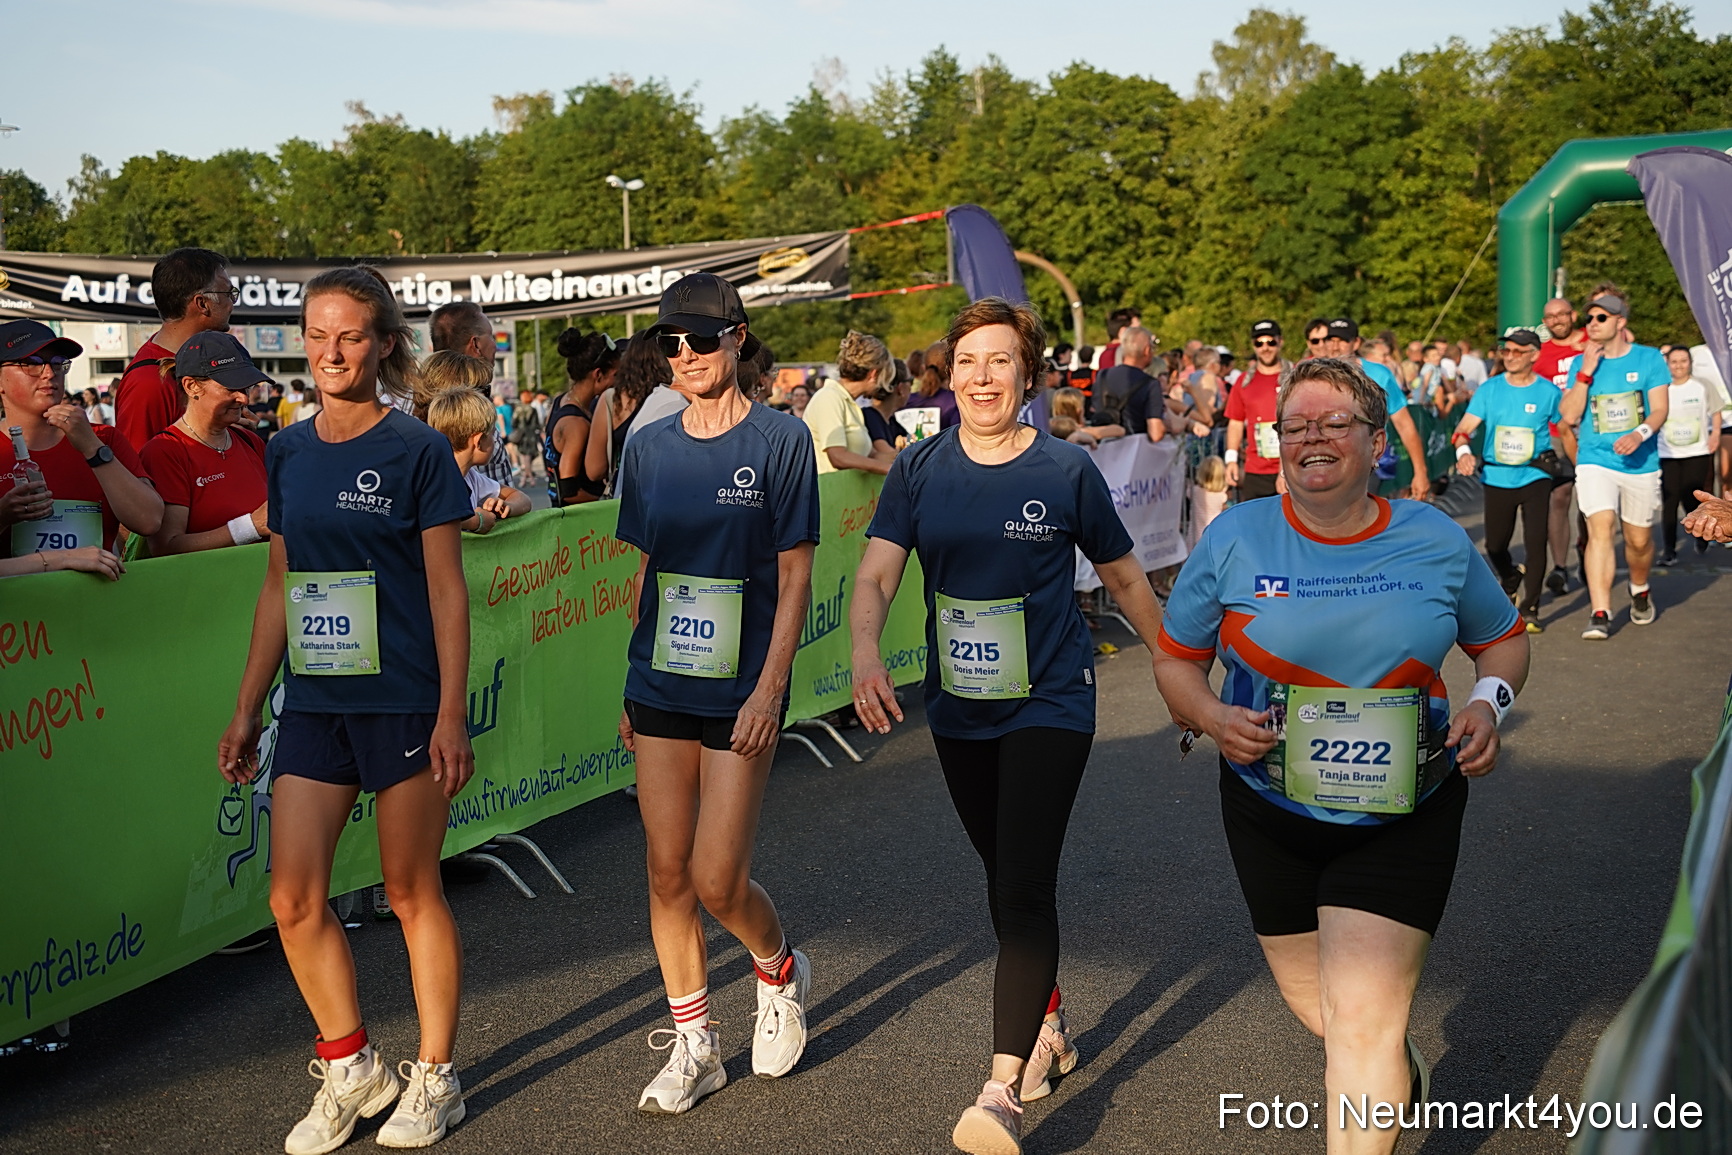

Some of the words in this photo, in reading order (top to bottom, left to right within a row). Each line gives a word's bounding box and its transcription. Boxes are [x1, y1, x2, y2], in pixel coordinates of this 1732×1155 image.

[61, 274, 130, 304] Auf
[338, 491, 393, 509] QUARTZ
[717, 488, 765, 501] QUARTZ
[336, 501, 391, 517] HEALTHCARE
[716, 498, 764, 509] HEALTHCARE
[36, 533, 78, 549] 790
[1003, 531, 1054, 542] HEALTHCARE
[487, 536, 573, 607] Gesunde
[1296, 572, 1387, 587] Raiffeisenbank
[1296, 586, 1358, 598] Neumarkt
[1408, 581, 1424, 591] eG
[531, 589, 588, 645] laufen
[302, 615, 351, 636] 2219
[669, 615, 715, 640] 2210
[300, 641, 335, 650] Katharina
[336, 641, 361, 650] Stark
[670, 640, 690, 652] Sigrid
[691, 643, 713, 654] Emra
[949, 638, 1000, 662] 2215
[954, 663, 973, 675] Doris
[974, 667, 1000, 676] Meier
[1320, 712, 1361, 720] Firmenlauf
[1310, 739, 1391, 766] 2222
[1318, 769, 1350, 783] Tanja
[1352, 772, 1387, 783] Brand
